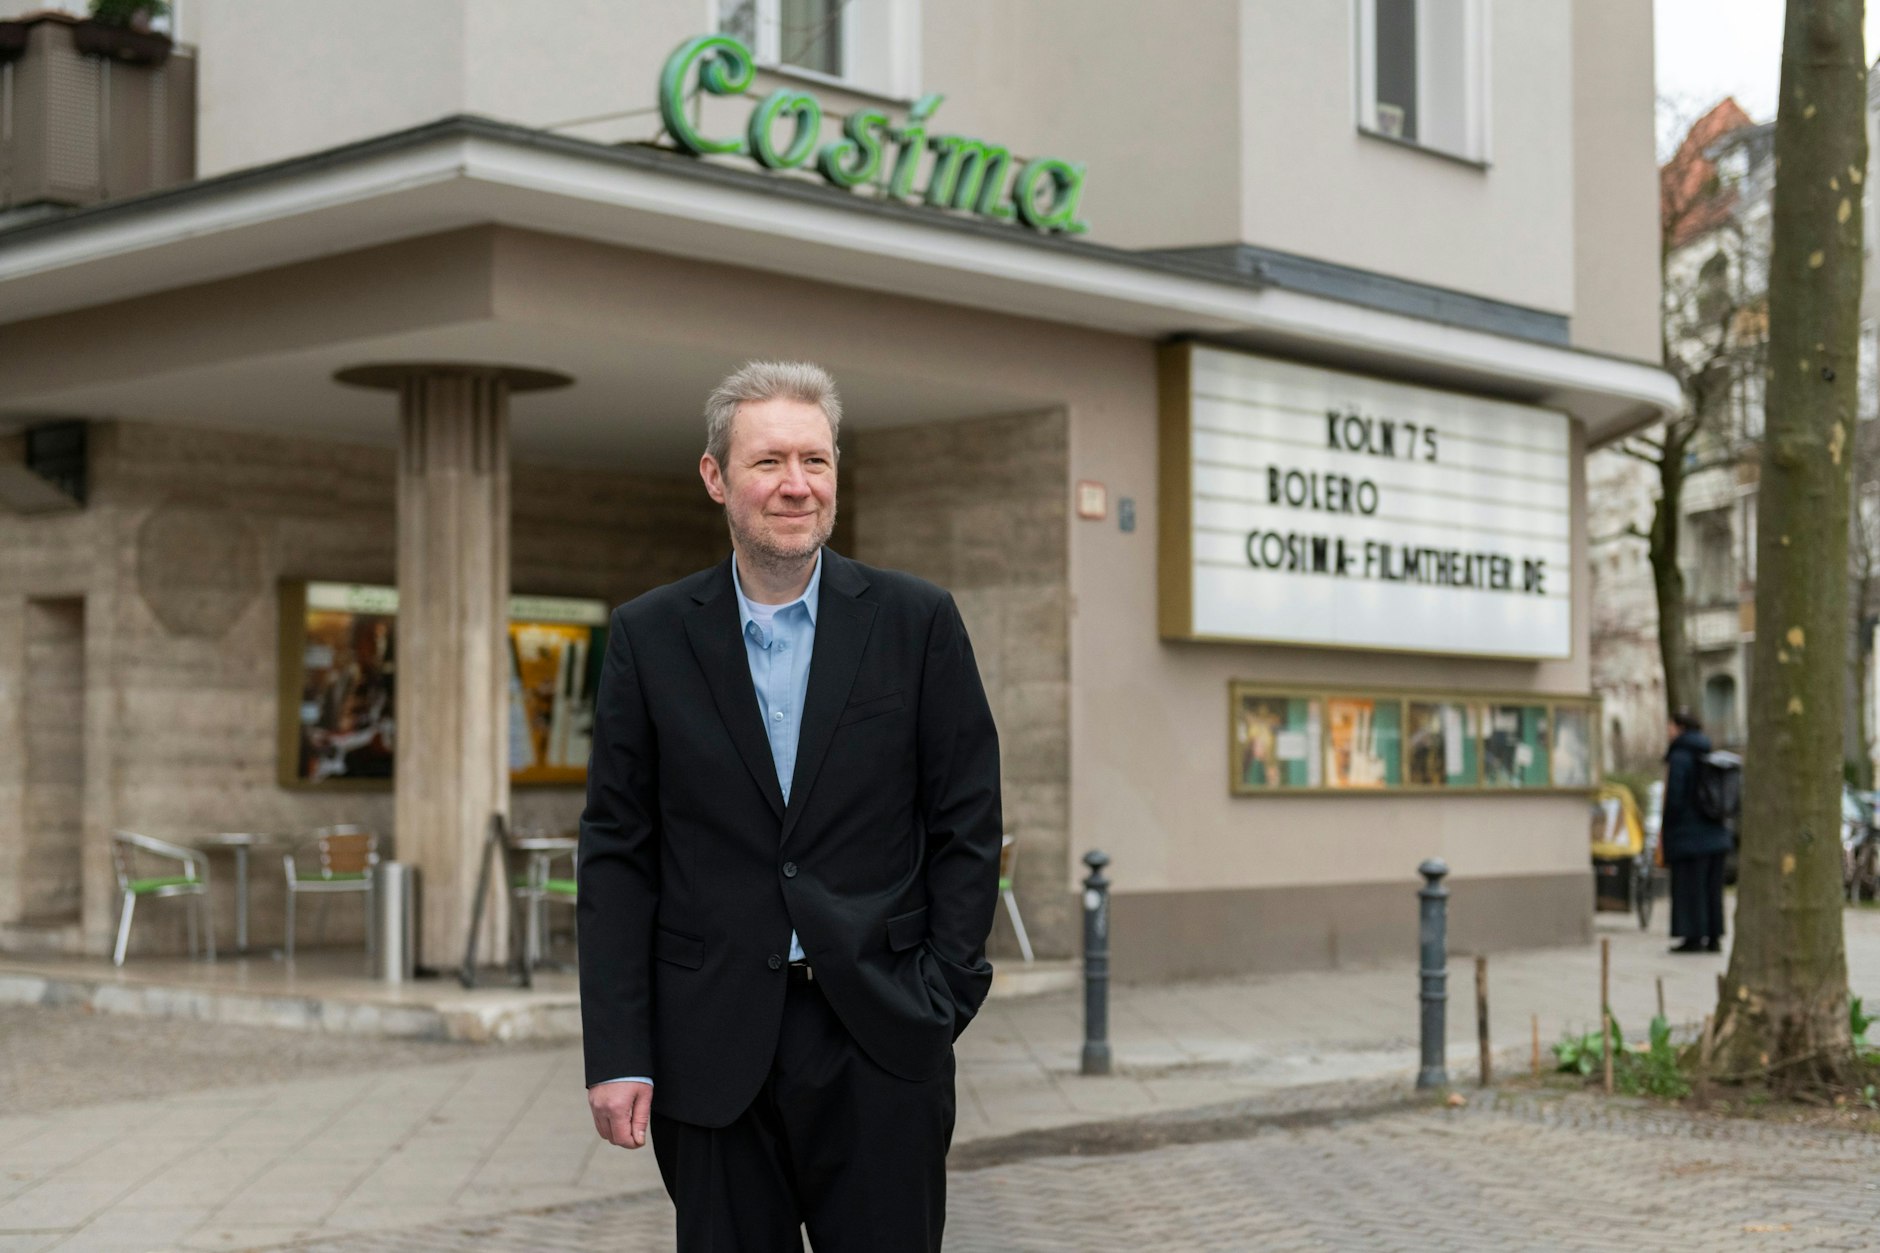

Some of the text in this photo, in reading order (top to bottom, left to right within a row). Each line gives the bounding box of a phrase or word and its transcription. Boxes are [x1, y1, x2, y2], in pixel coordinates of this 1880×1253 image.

[660, 33, 1090, 234] Cosima
[1326, 403, 1437, 462] KÖLN 75
[1268, 465, 1378, 515] BOLERO
